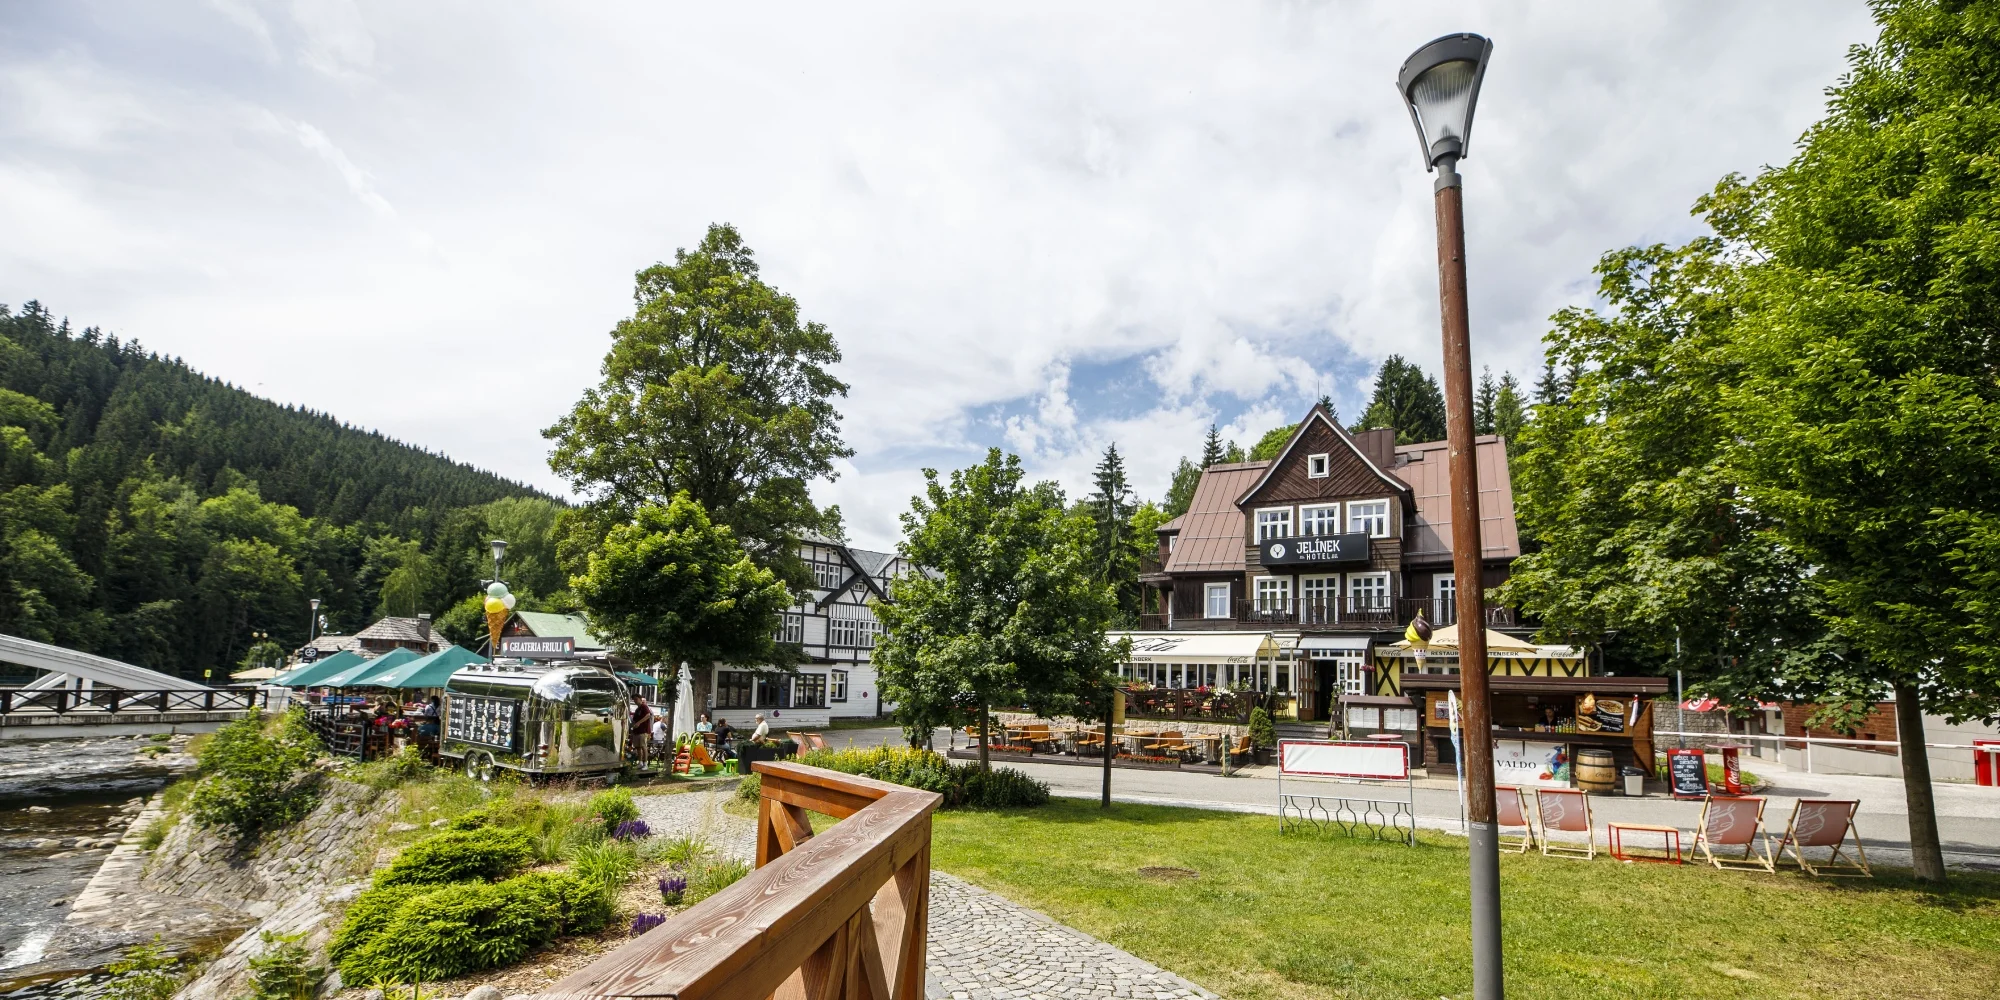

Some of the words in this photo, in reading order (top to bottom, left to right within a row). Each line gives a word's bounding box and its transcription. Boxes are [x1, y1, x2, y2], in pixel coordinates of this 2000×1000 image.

[1296, 538, 1341, 554] JELÍNEK
[1306, 552, 1331, 560] HOTEL
[509, 641, 541, 652] GELATERIA
[542, 641, 563, 652] FRIULI
[1226, 655, 1249, 664] Coca-Cola
[1496, 759, 1537, 769] VALDO
